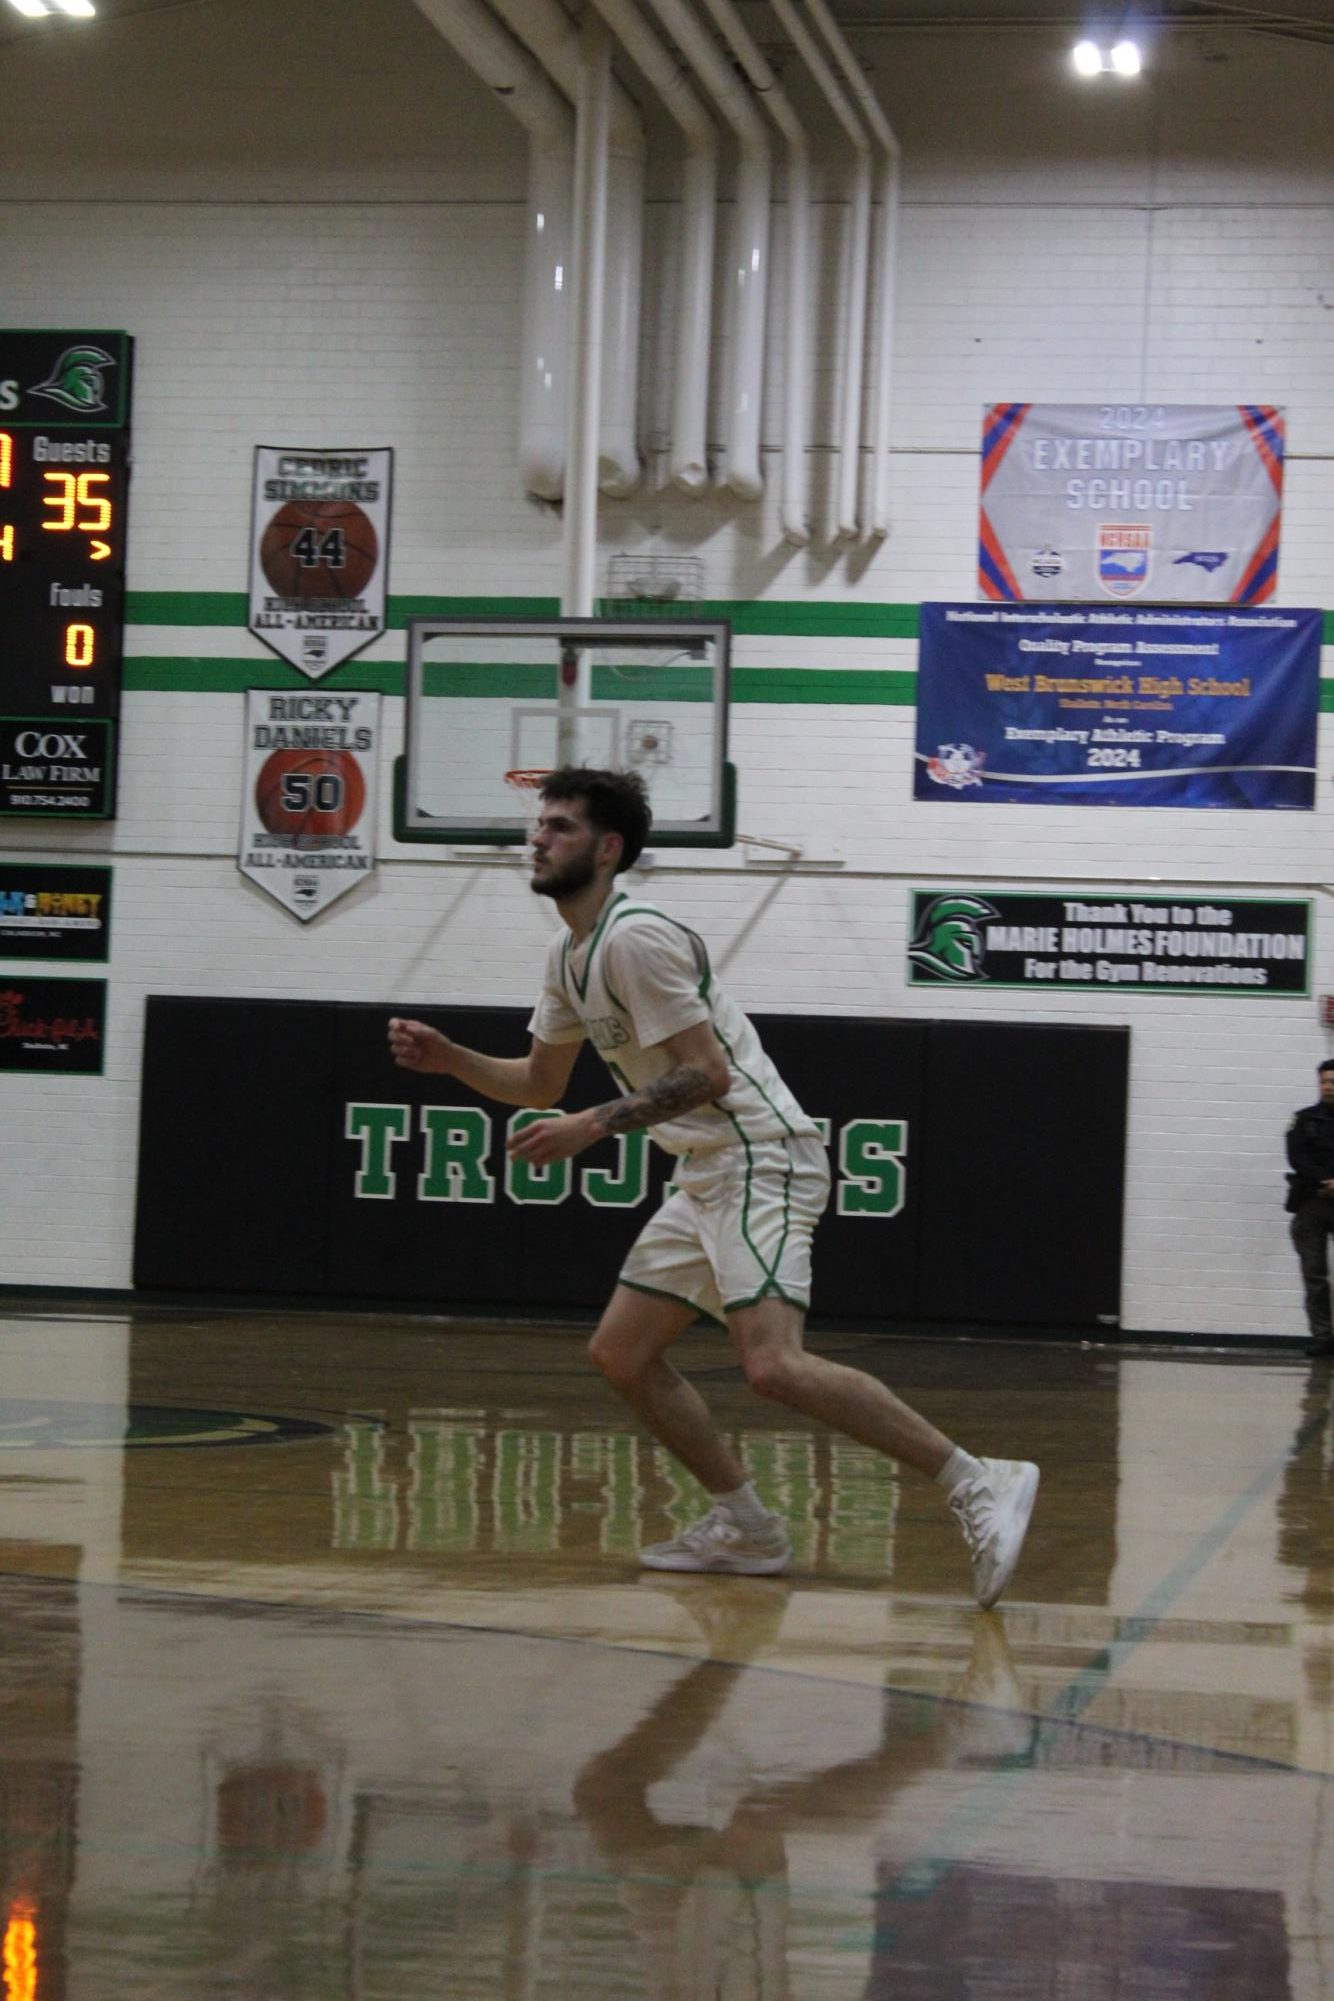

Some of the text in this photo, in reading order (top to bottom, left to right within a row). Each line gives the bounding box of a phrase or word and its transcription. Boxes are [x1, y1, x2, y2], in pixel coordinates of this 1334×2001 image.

[1100, 407, 1166, 430] 2024
[33, 436, 111, 462] Guests
[1033, 439, 1233, 472] EXEMPLARY
[42, 473, 112, 530] 35
[1066, 479, 1194, 511] SCHOOL
[291, 528, 345, 568] 44
[66, 624, 95, 667] 0
[985, 674, 1250, 698] West Brunswick High School
[268, 696, 358, 720] RICKY
[15, 731, 88, 759] COX
[253, 725, 371, 751] DANIELS
[1005, 727, 1089, 743] Exemplary
[1087, 748, 1141, 768] 2024
[2, 764, 101, 782] LAW FIRM
[280, 774, 343, 813] 50
[1064, 902, 1233, 926] Thank You to the
[986, 926, 1306, 960] MARIE HOLMES FOUNDATION
[1024, 958, 1268, 985] For the Gym Renovations
[345, 1102, 908, 1218] TROJS
